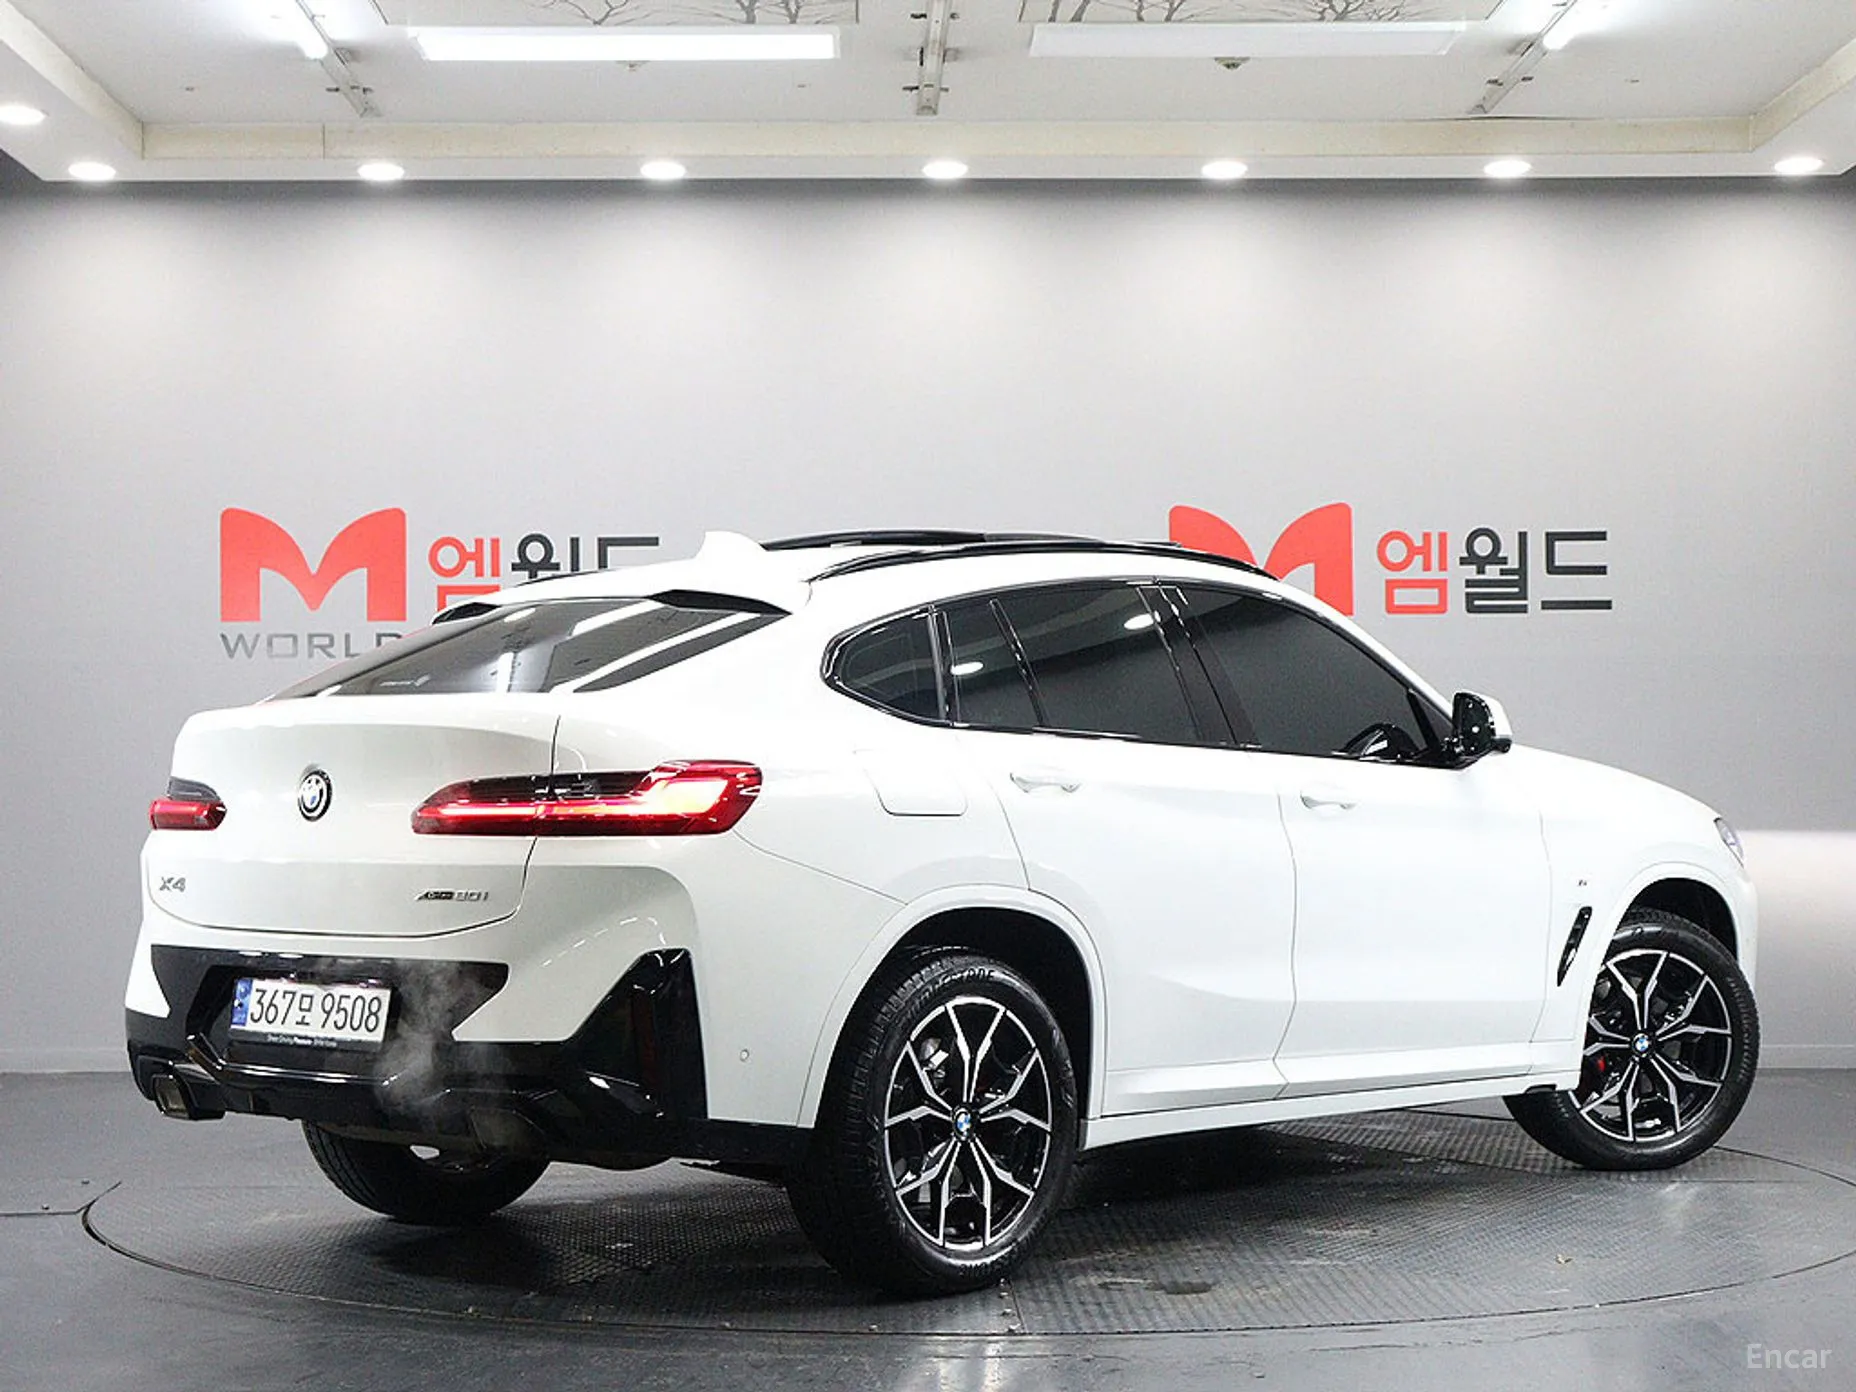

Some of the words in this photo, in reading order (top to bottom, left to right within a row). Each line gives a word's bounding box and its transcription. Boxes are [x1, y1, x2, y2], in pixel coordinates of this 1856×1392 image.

[1376, 527, 1613, 615] 엠월드
[159, 876, 186, 893] X4
[250, 988, 314, 1026] 367모
[321, 993, 382, 1033] 9508
